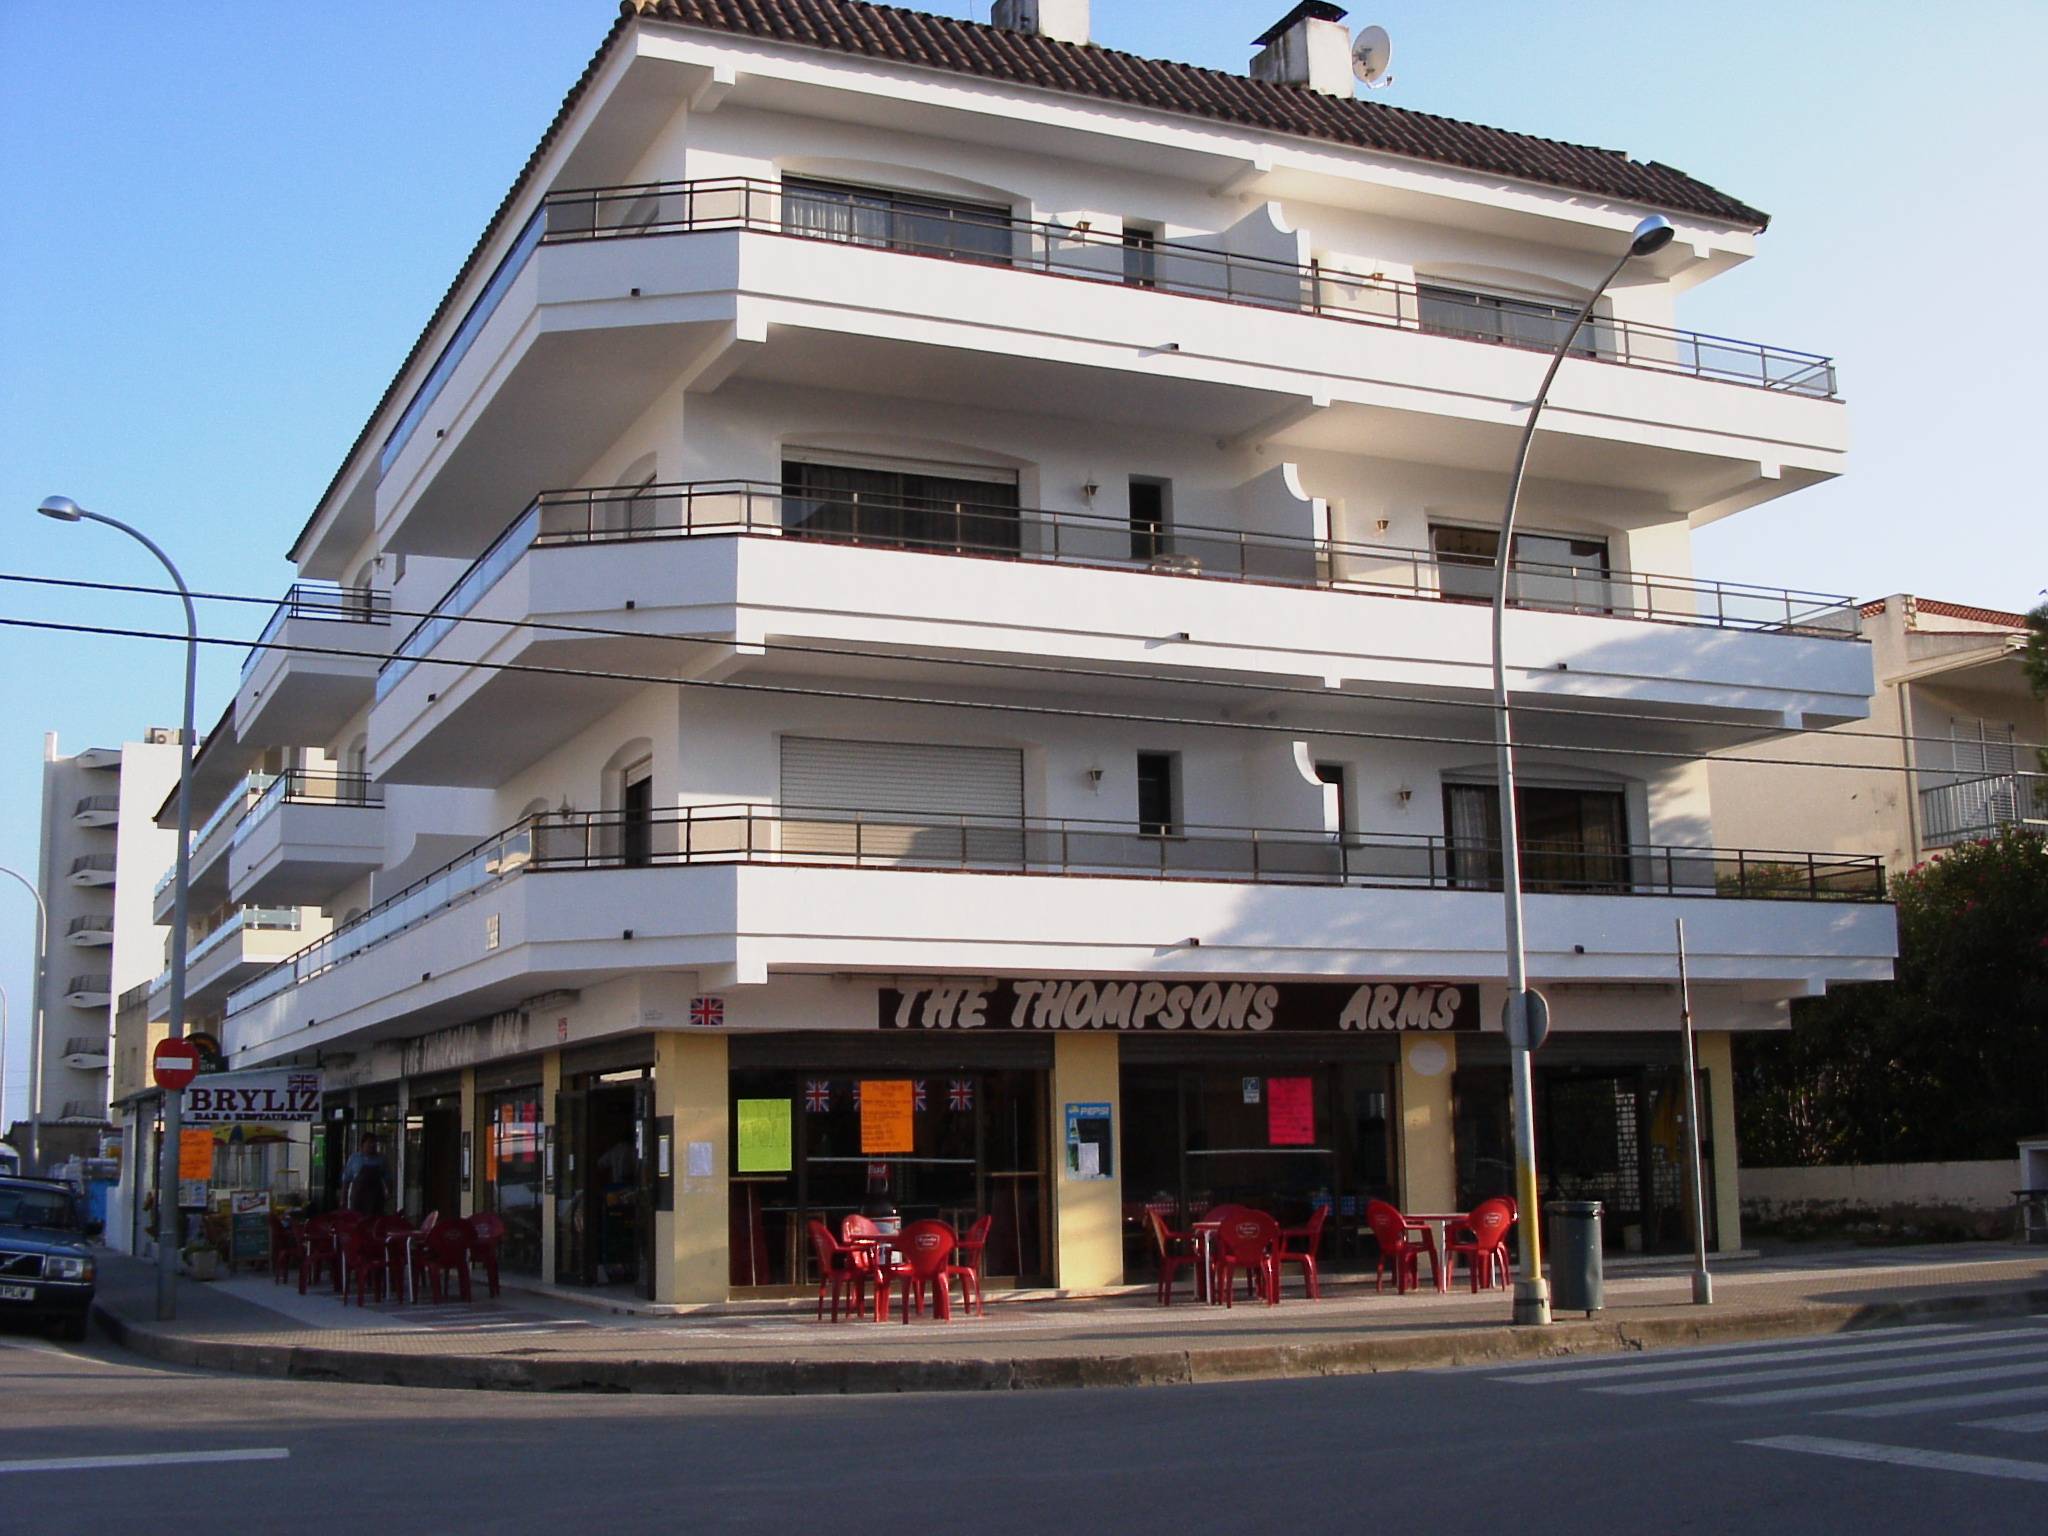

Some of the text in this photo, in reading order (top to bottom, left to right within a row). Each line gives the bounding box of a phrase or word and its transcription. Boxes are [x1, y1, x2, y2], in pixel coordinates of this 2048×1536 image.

[895, 981, 1461, 1031] THE THOMPSONS ARMS
[189, 1088, 319, 1112] BRYLIZ
[194, 1112, 219, 1120] BAR
[235, 1112, 313, 1121] RESTAURANT
[1080, 1105, 1110, 1116] PEPSI
